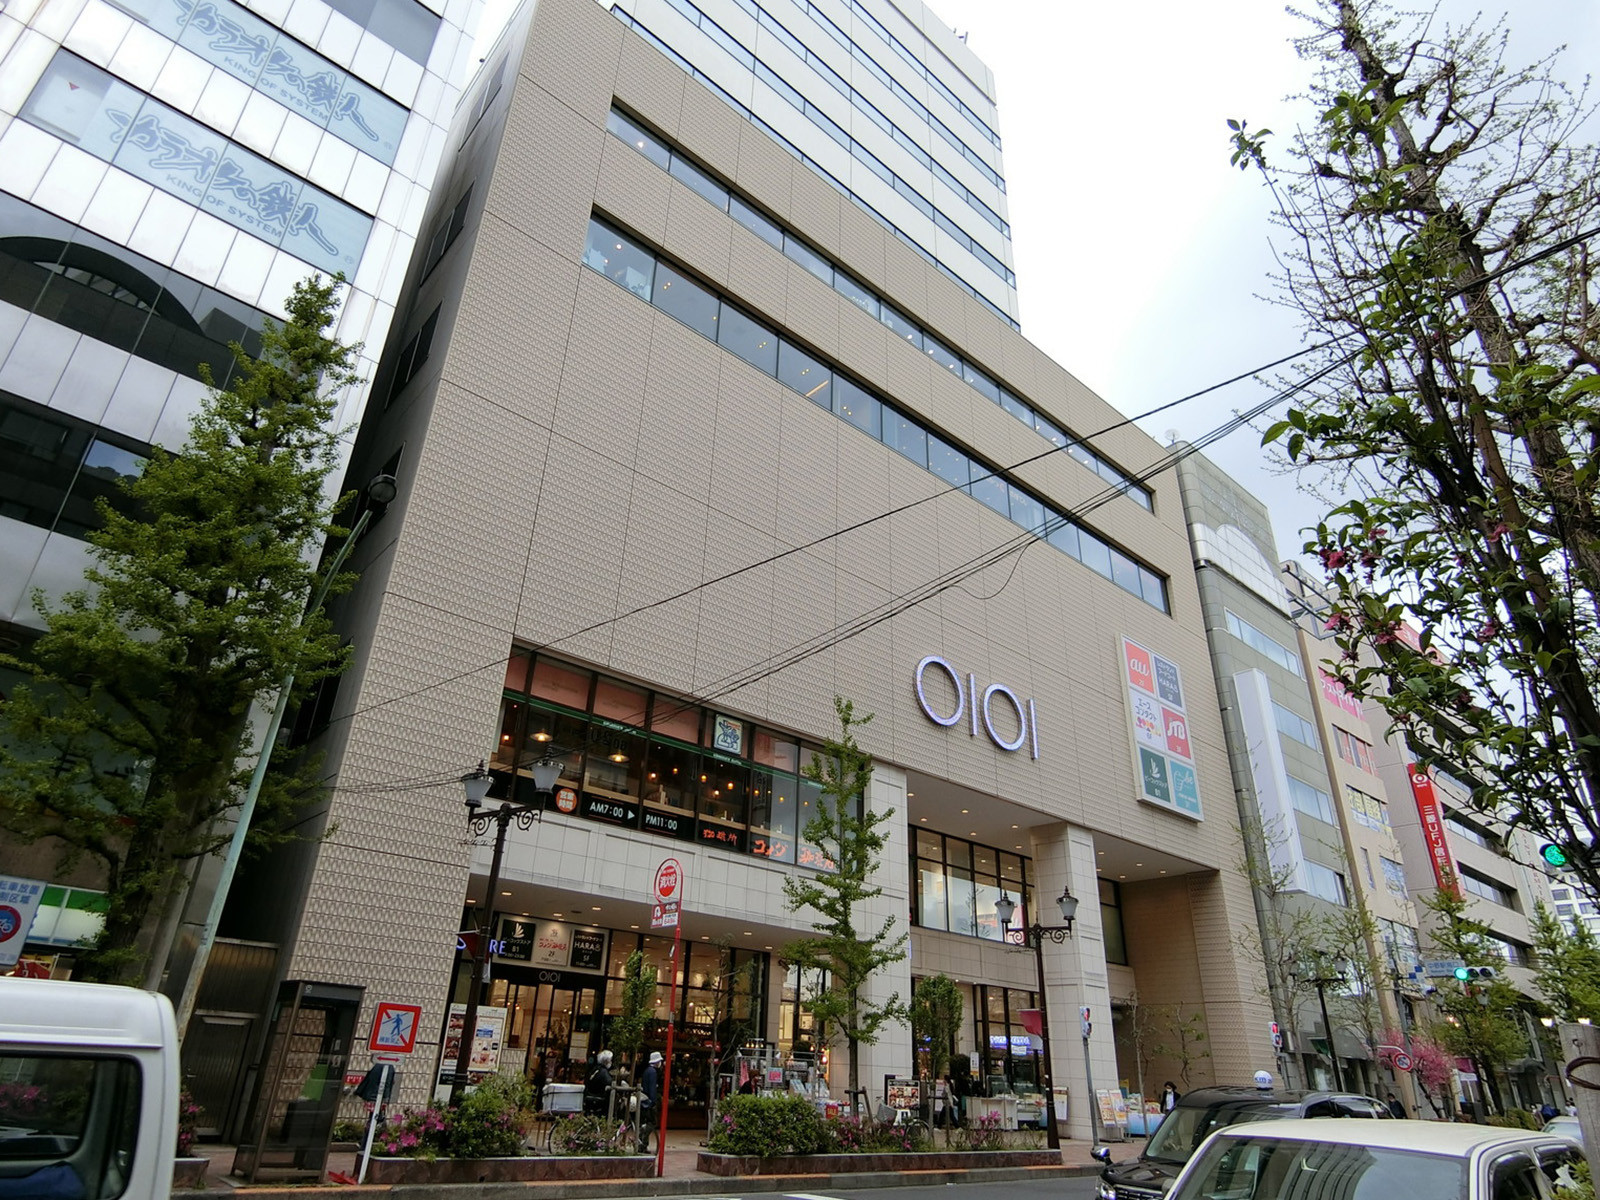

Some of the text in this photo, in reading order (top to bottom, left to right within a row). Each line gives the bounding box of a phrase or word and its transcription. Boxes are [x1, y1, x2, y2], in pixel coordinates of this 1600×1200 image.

[223, 56, 329, 122] KING OF SYSTEM
[105, 107, 339, 256] カラオケの鉄人
[165, 173, 284, 238] KING OF SYSTEM
[1130, 658, 1150, 677] au
[1167, 720, 1186, 740] JTB
[589, 801, 624, 818] AM7:00
[645, 814, 678, 831] PM11:00
[753, 839, 788, 857] コメダ
